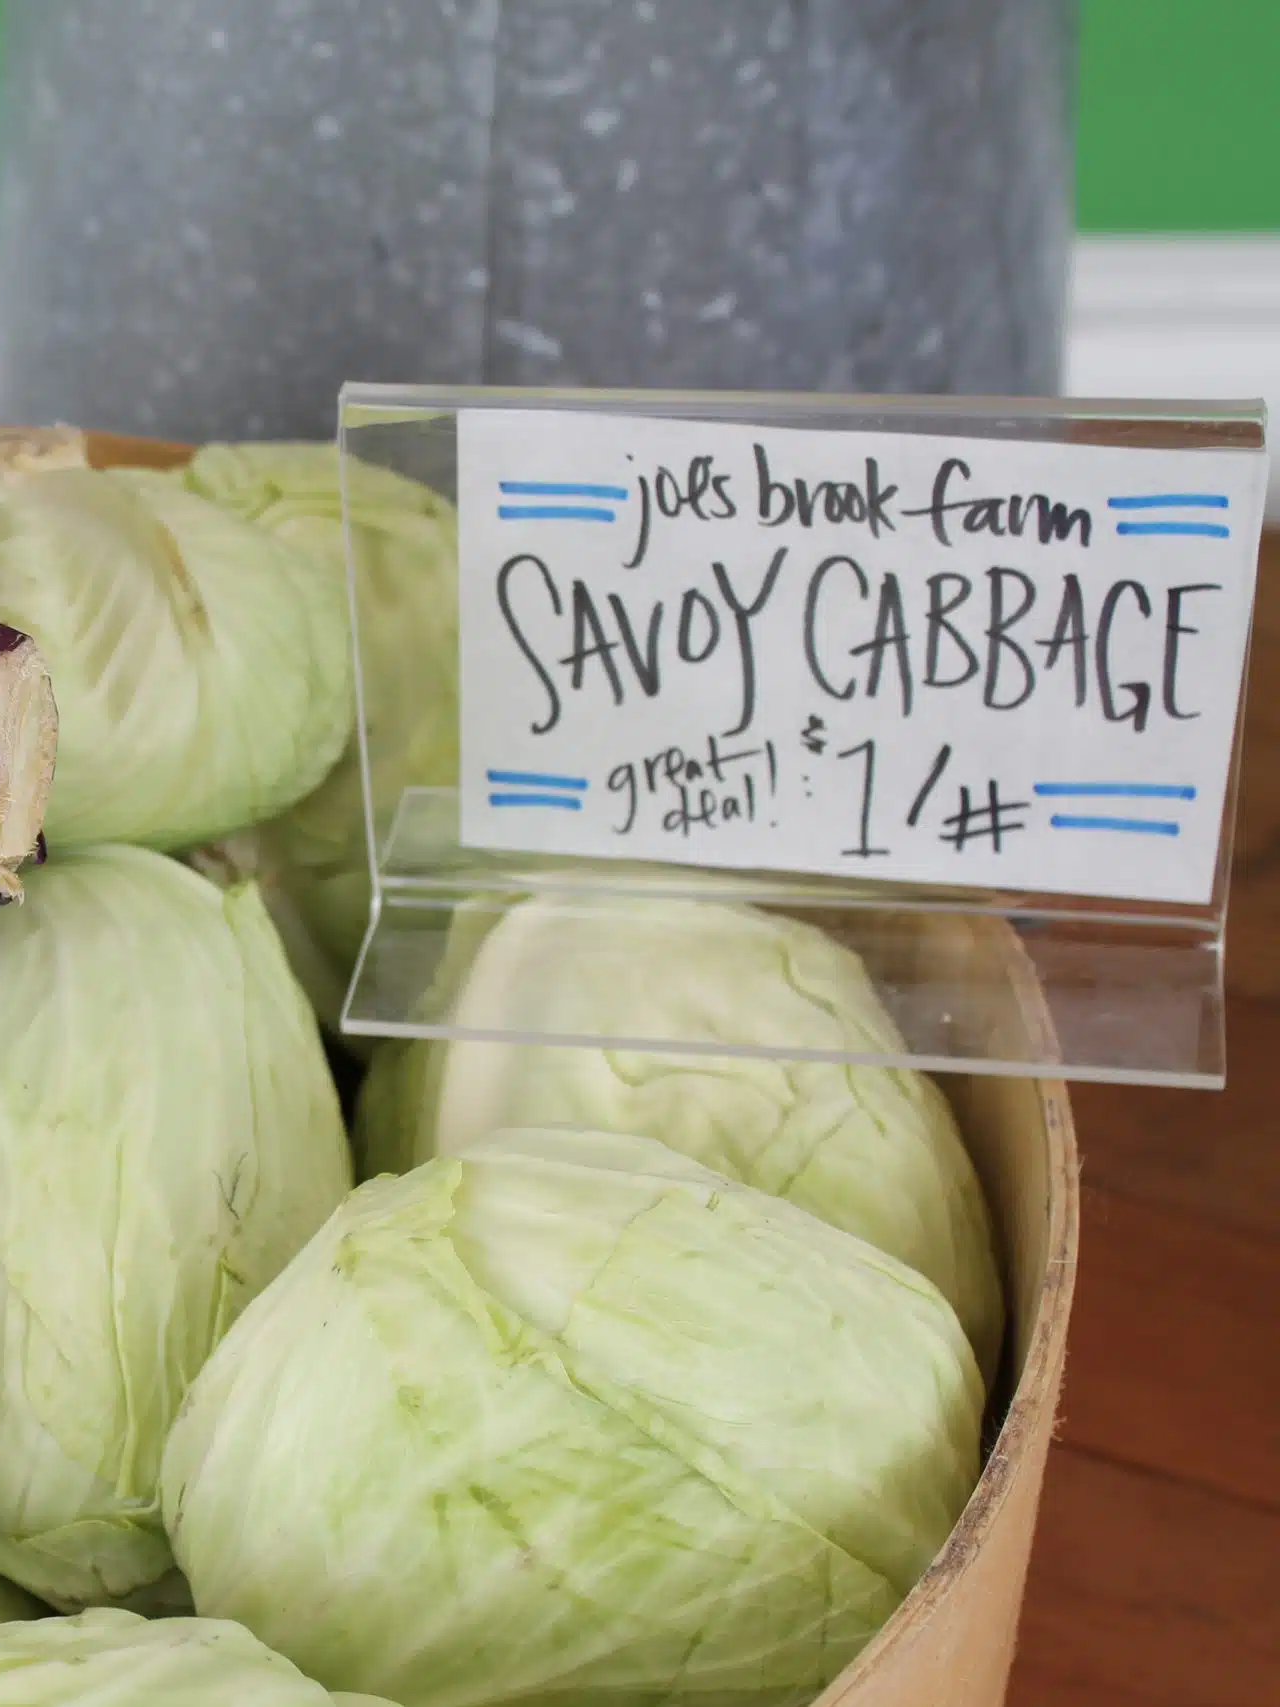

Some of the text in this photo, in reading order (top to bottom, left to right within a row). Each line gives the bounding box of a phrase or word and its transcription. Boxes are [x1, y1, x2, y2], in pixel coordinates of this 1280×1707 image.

[622, 443, 1093, 569] joes brook farm
[497, 546, 1223, 738] SAVOY CABBAGE
[607, 734, 764, 835] great
